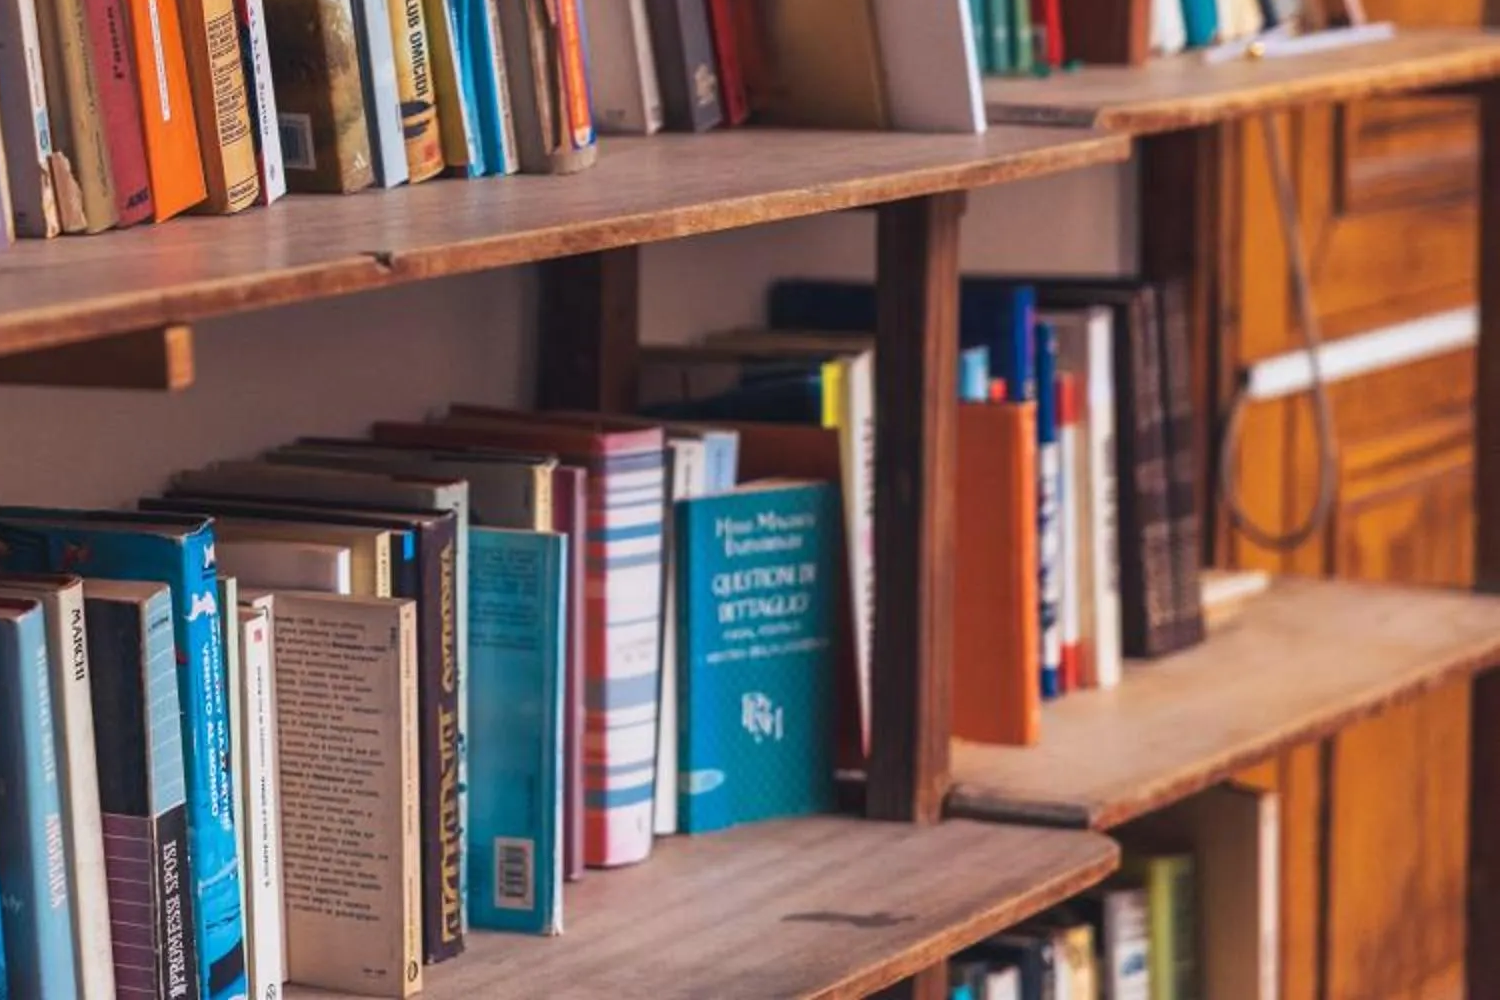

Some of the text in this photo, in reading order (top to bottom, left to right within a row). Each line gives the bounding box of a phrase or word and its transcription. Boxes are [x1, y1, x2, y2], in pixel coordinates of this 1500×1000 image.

[408, 28, 430, 97] OMICIDI
[200, 641, 220, 817] VENUTO AL MONDO
[163, 840, 179, 895] SPOSI
[166, 894, 187, 986] PROMESSI
